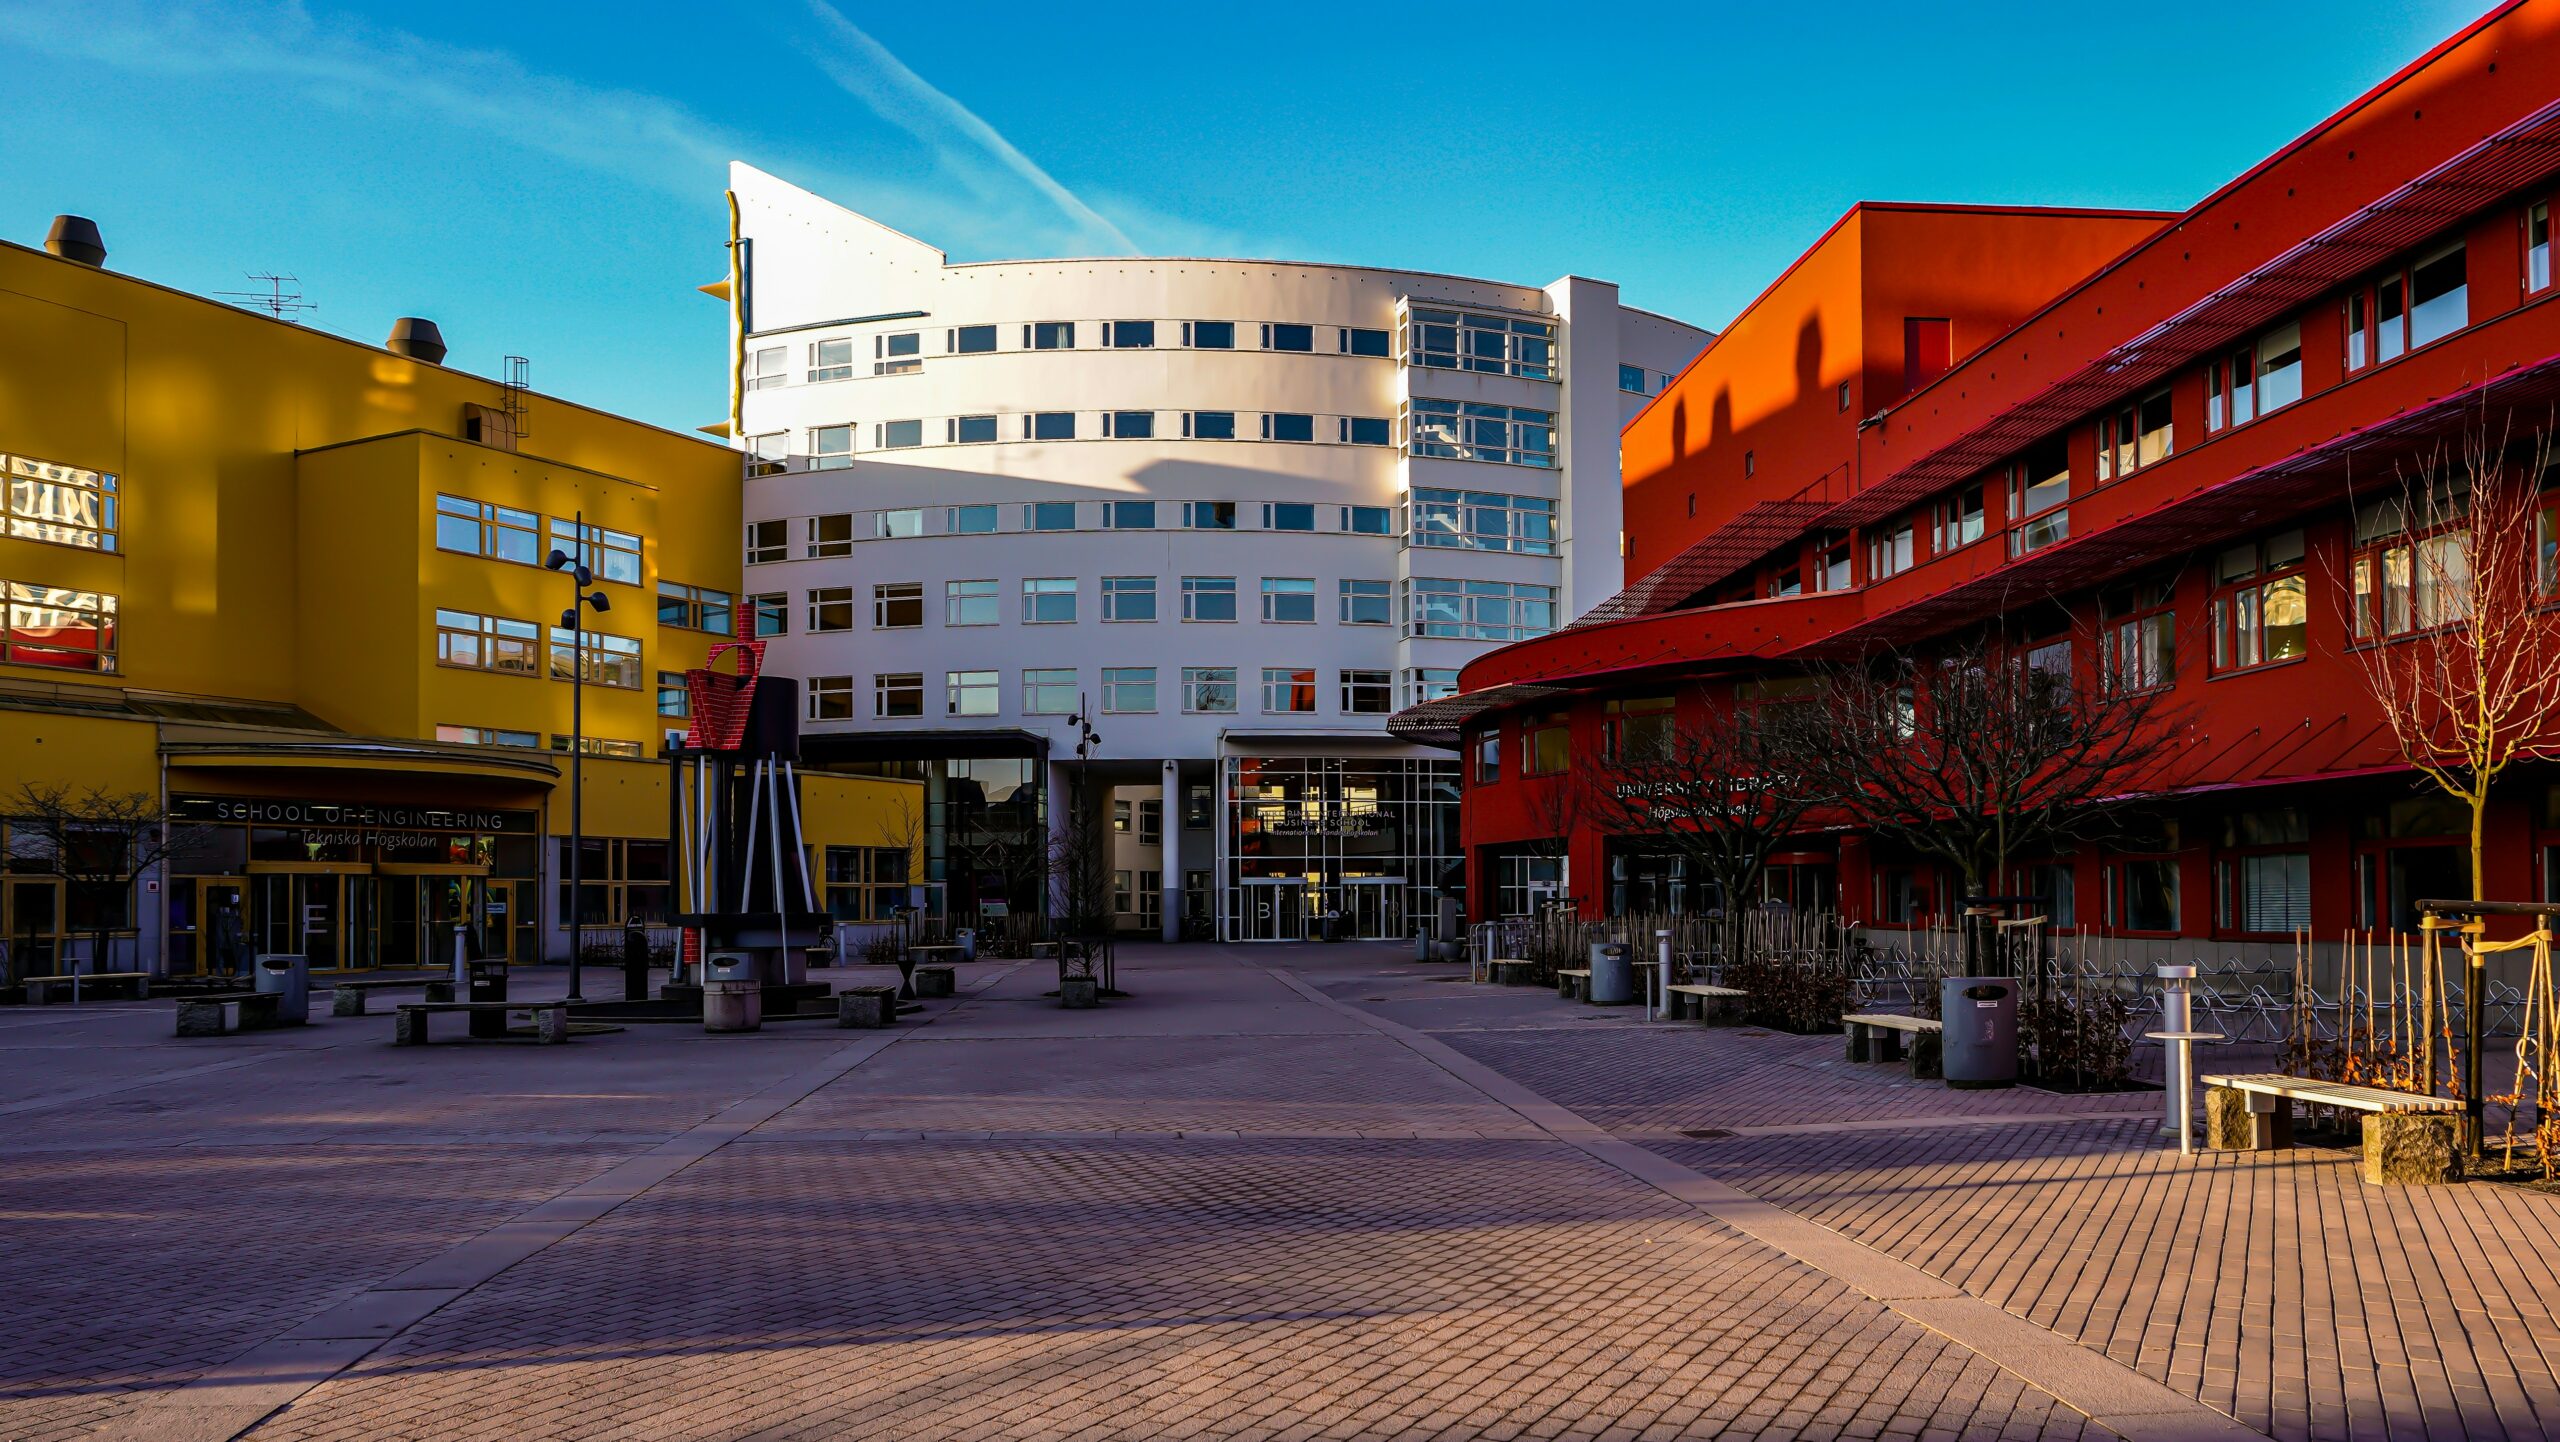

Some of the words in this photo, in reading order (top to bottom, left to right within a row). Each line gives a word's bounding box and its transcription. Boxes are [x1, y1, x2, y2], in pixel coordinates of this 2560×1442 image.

[217, 802, 314, 822] SCHOOL
[325, 807, 354, 823] OF
[364, 808, 502, 829] ENGINEERING
[1330, 818, 1371, 827] SCHOOL
[301, 829, 361, 847] Tekniska
[365, 831, 437, 851] Högskolan
[304, 904, 328, 934] E
[1257, 902, 1271, 919] B
